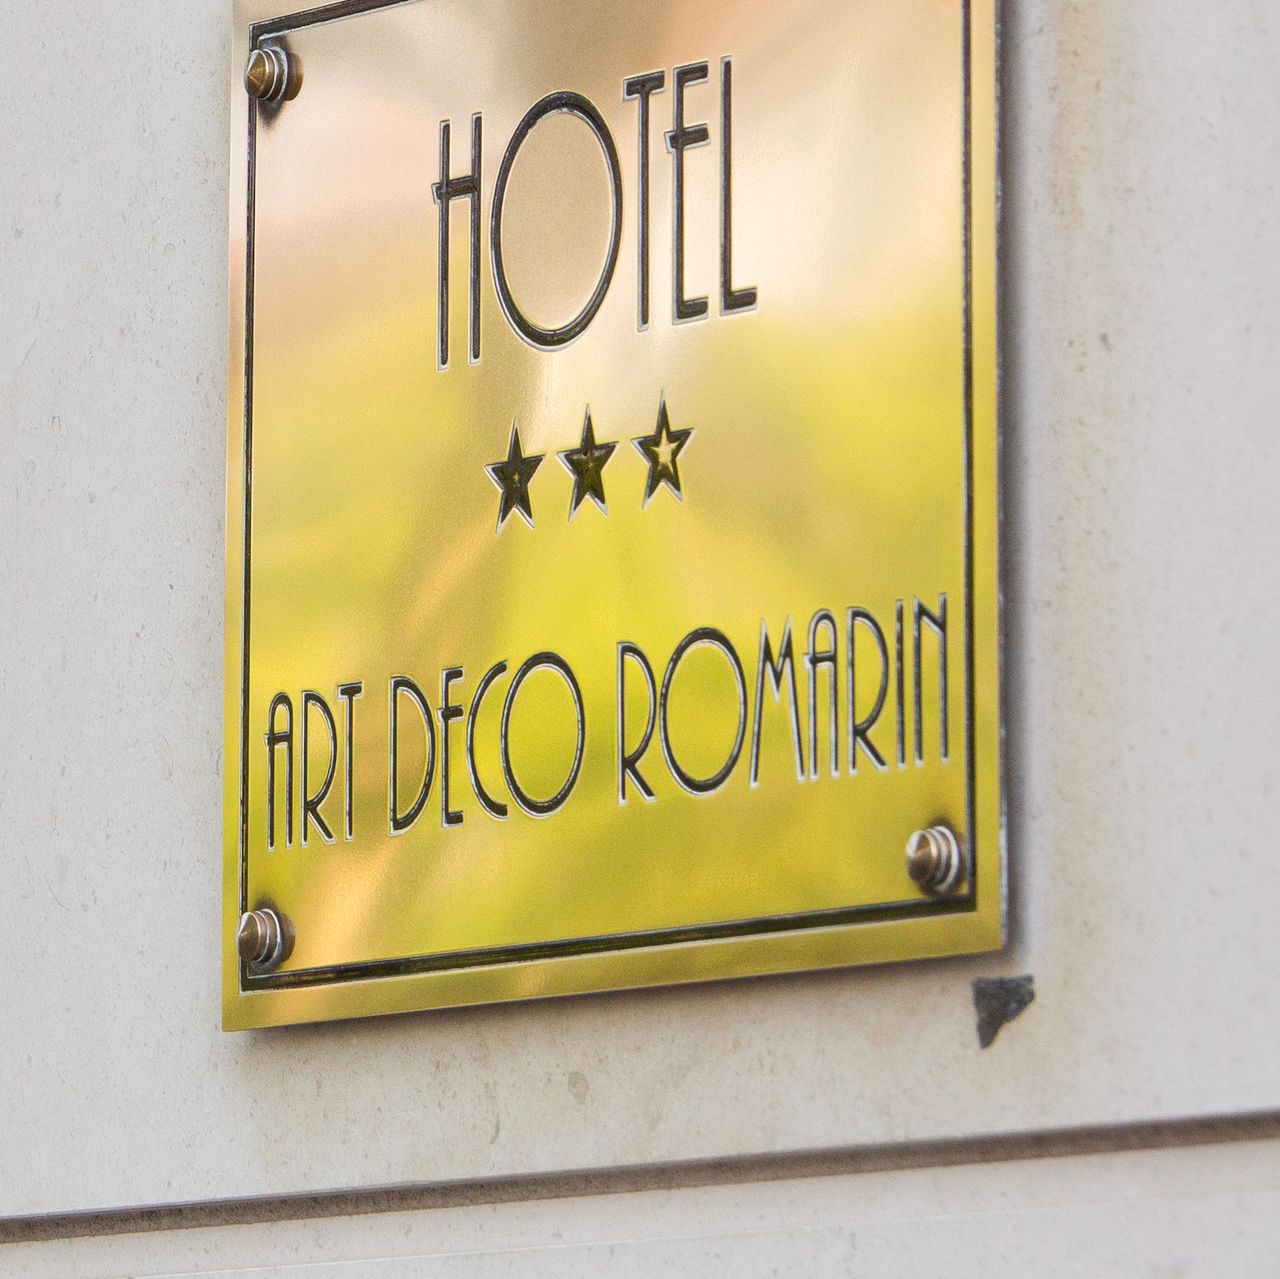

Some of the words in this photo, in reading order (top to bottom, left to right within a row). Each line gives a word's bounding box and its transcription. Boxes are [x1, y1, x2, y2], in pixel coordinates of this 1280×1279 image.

[431, 54, 757, 371] HOTEL
[264, 681, 363, 852] ART
[389, 651, 586, 837] DECO
[617, 592, 948, 806] ROMARIN
